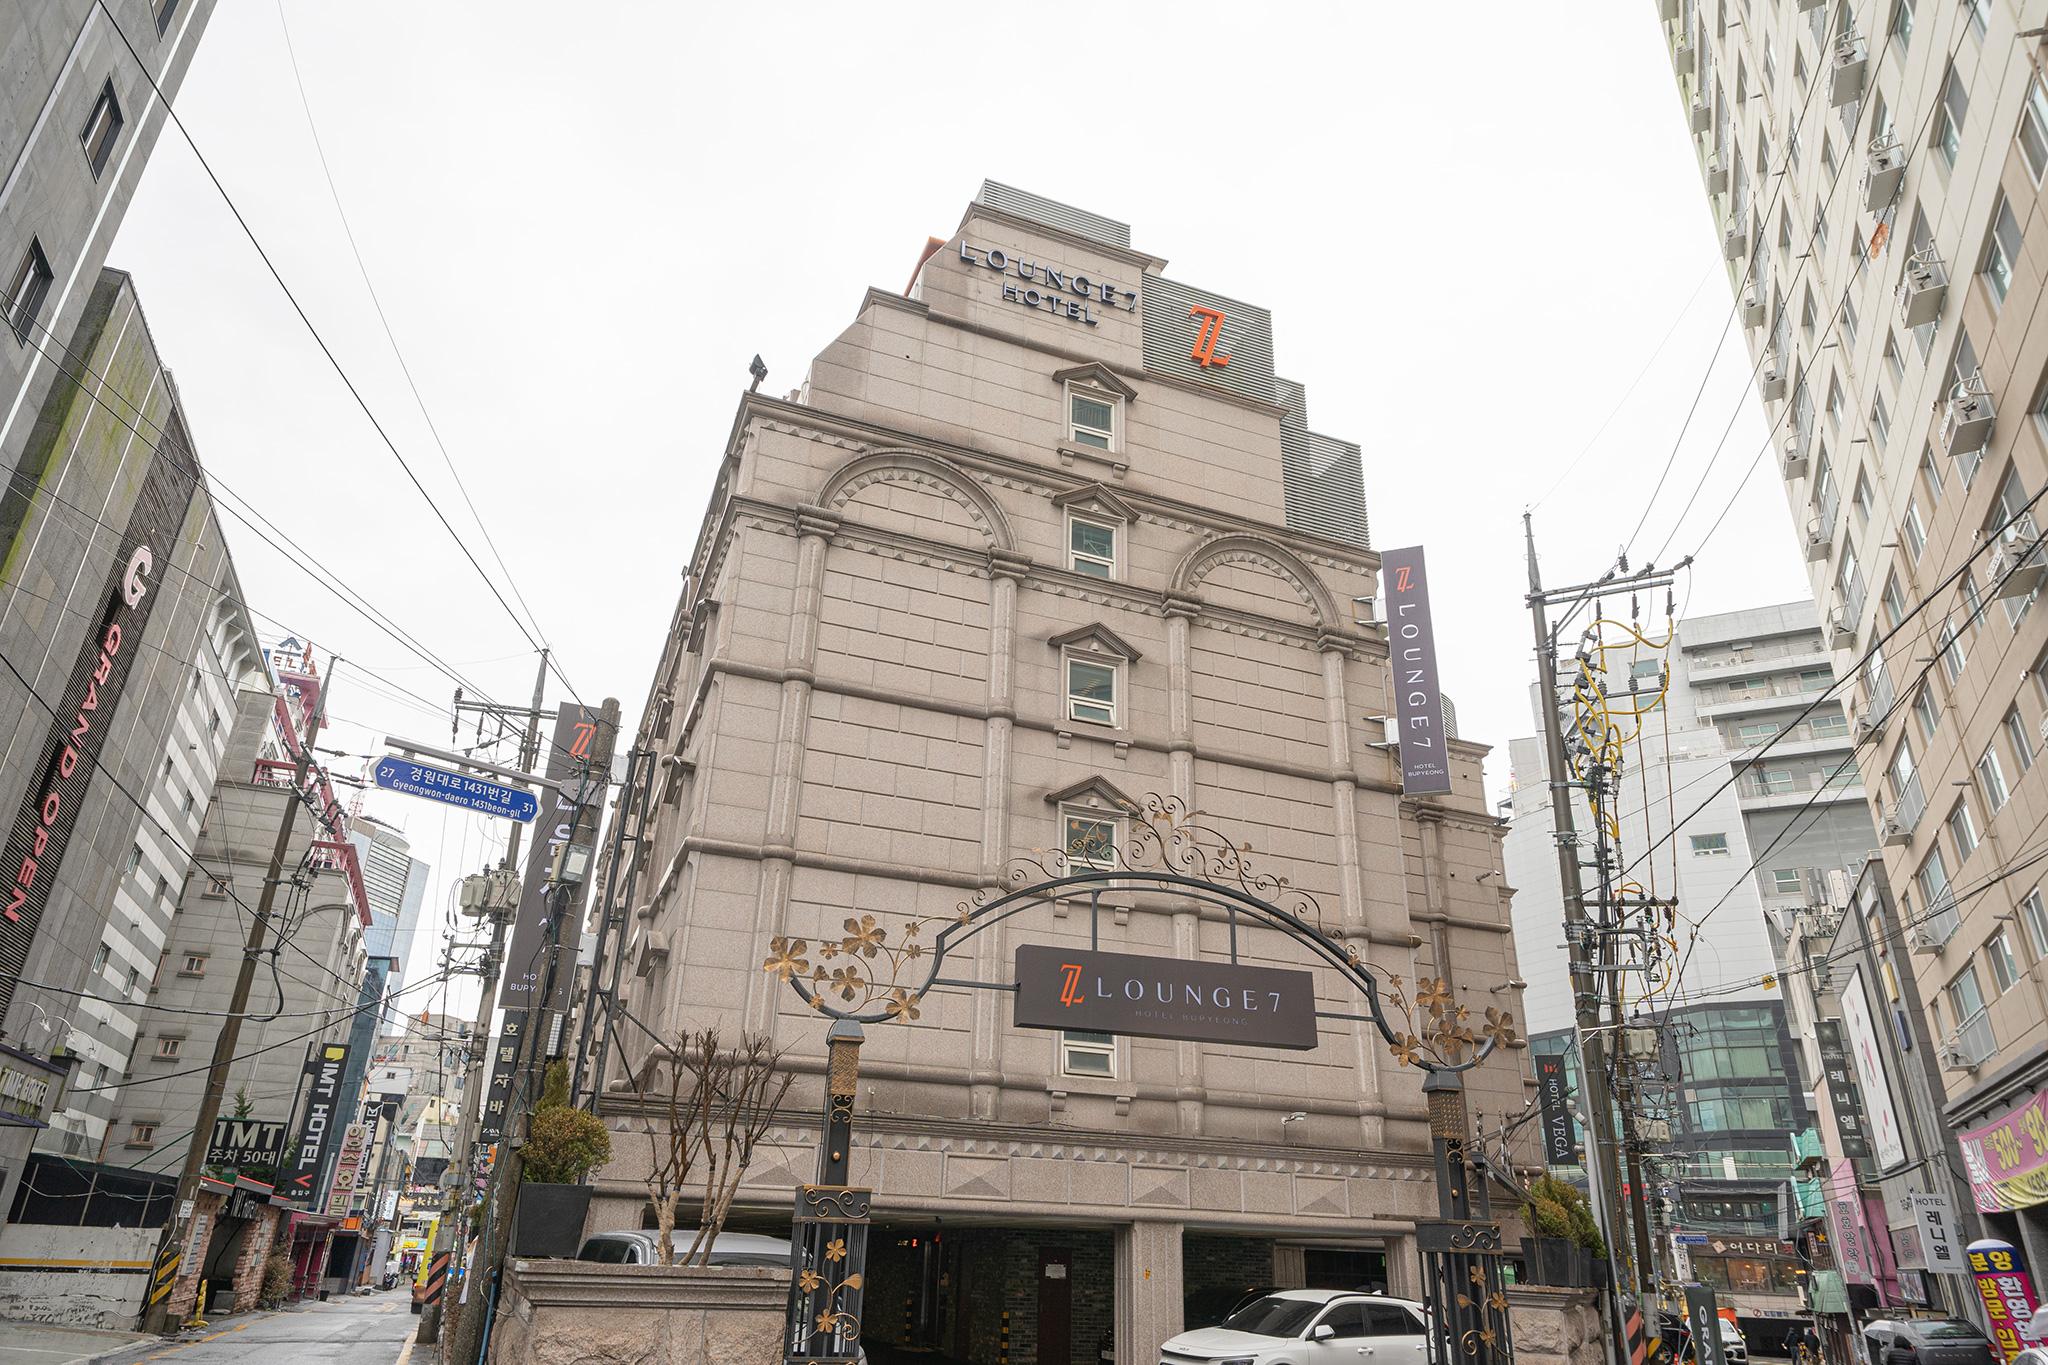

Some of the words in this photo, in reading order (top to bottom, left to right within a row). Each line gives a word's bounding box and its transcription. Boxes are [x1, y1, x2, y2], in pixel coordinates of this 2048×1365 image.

[1003, 281, 1098, 327] HOTEL
[58, 624, 121, 780] GRAND
[380, 766, 395, 779] 27
[392, 776, 469, 806] Gyeongwon-daero
[471, 798, 521, 819] 1431beon-gil
[522, 802, 534, 814] 31
[3, 793, 60, 922] OPEN
[317, 1063, 340, 1098] IMT
[1830, 1070, 1857, 1130] 레니엘
[213, 1121, 284, 1149] IMT
[298, 1104, 330, 1170] HOTEL
[1552, 1116, 1568, 1158] VEGA
[209, 1149, 238, 1163] 주차
[242, 1150, 276, 1165] 50대
[1915, 1198, 1947, 1207] HOTEL
[1730, 1242, 1778, 1255] 어다리
[1926, 1211, 1951, 1260] 레니엘
[1968, 1251, 2014, 1272] 분양
[1699, 1306, 1713, 1365] GRA
